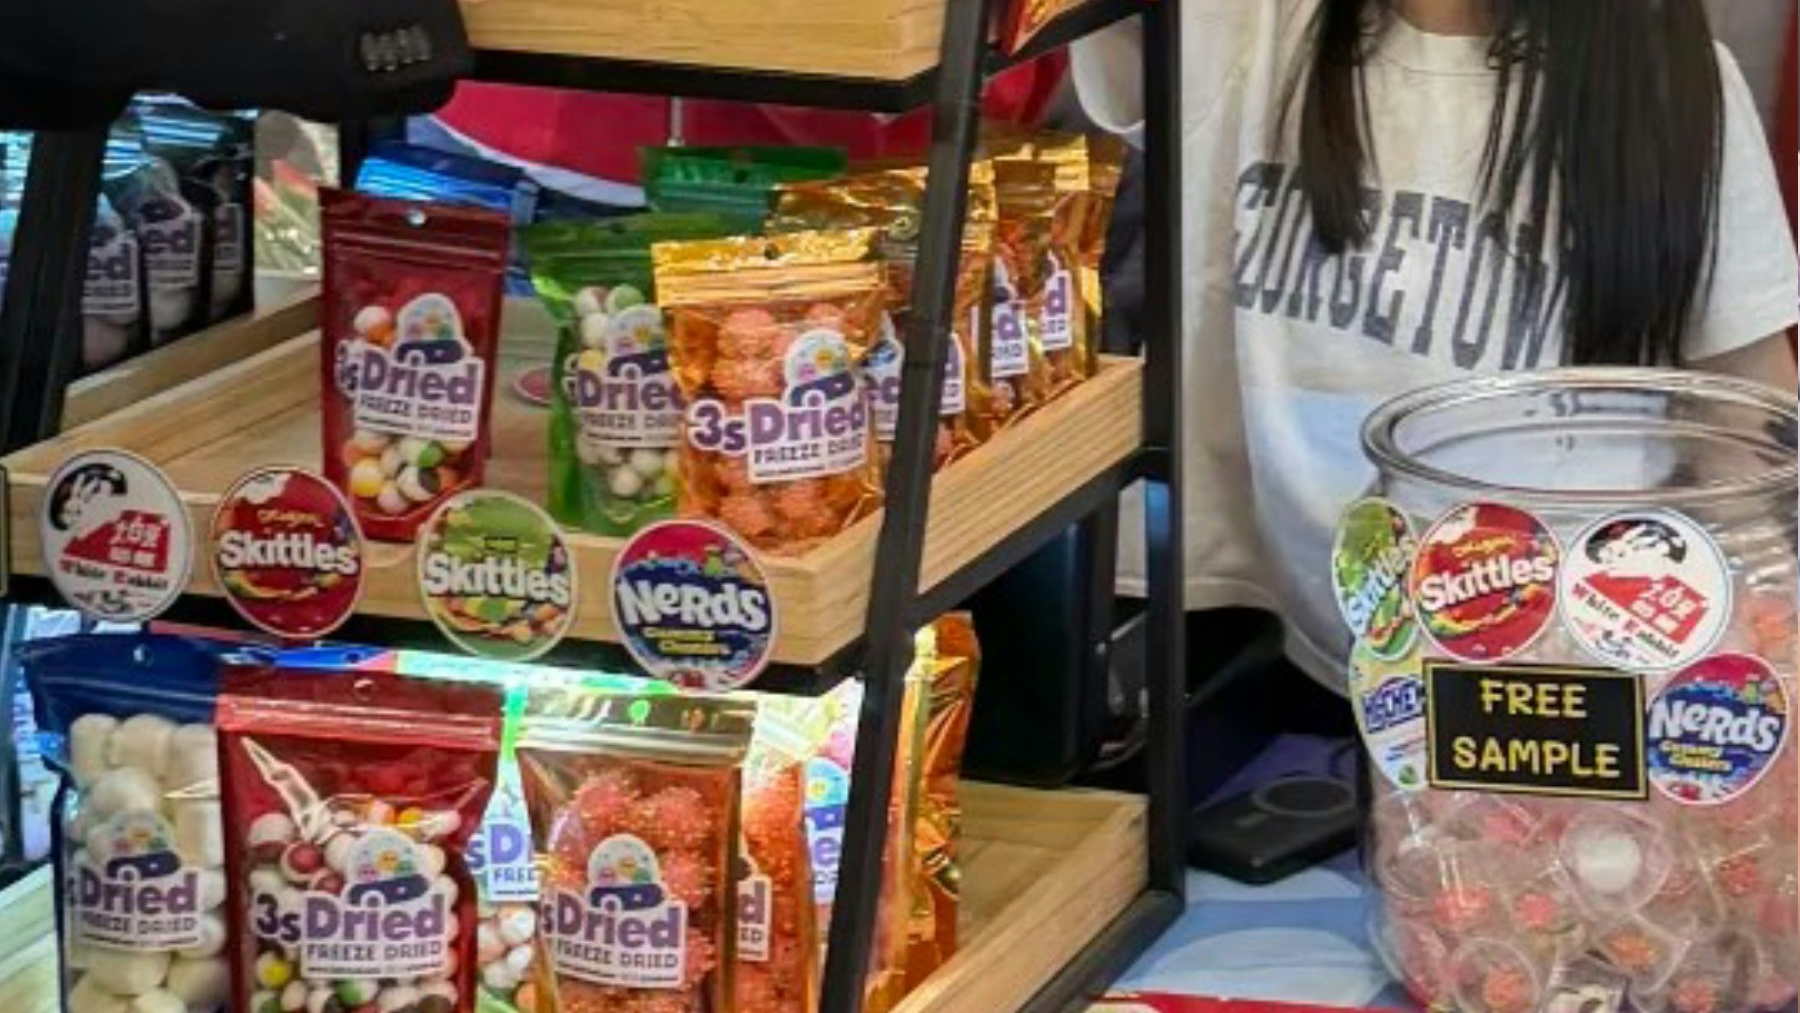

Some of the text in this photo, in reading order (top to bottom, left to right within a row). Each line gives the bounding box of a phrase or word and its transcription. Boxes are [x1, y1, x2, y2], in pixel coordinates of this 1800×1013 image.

[219, 529, 359, 575] Skittles
[424, 551, 570, 606] Skittles
[1419, 552, 1553, 612] Skittles
[1479, 678, 1588, 720] FREE
[1452, 735, 1622, 779] SAMPLE
[493, 868, 537, 884] FREE
[256, 892, 445, 943] 3sDried
[541, 888, 680, 949] sDried
[306, 940, 443, 963] FREEZE DRIED
[557, 938, 679, 968] FREEZE DRIED
